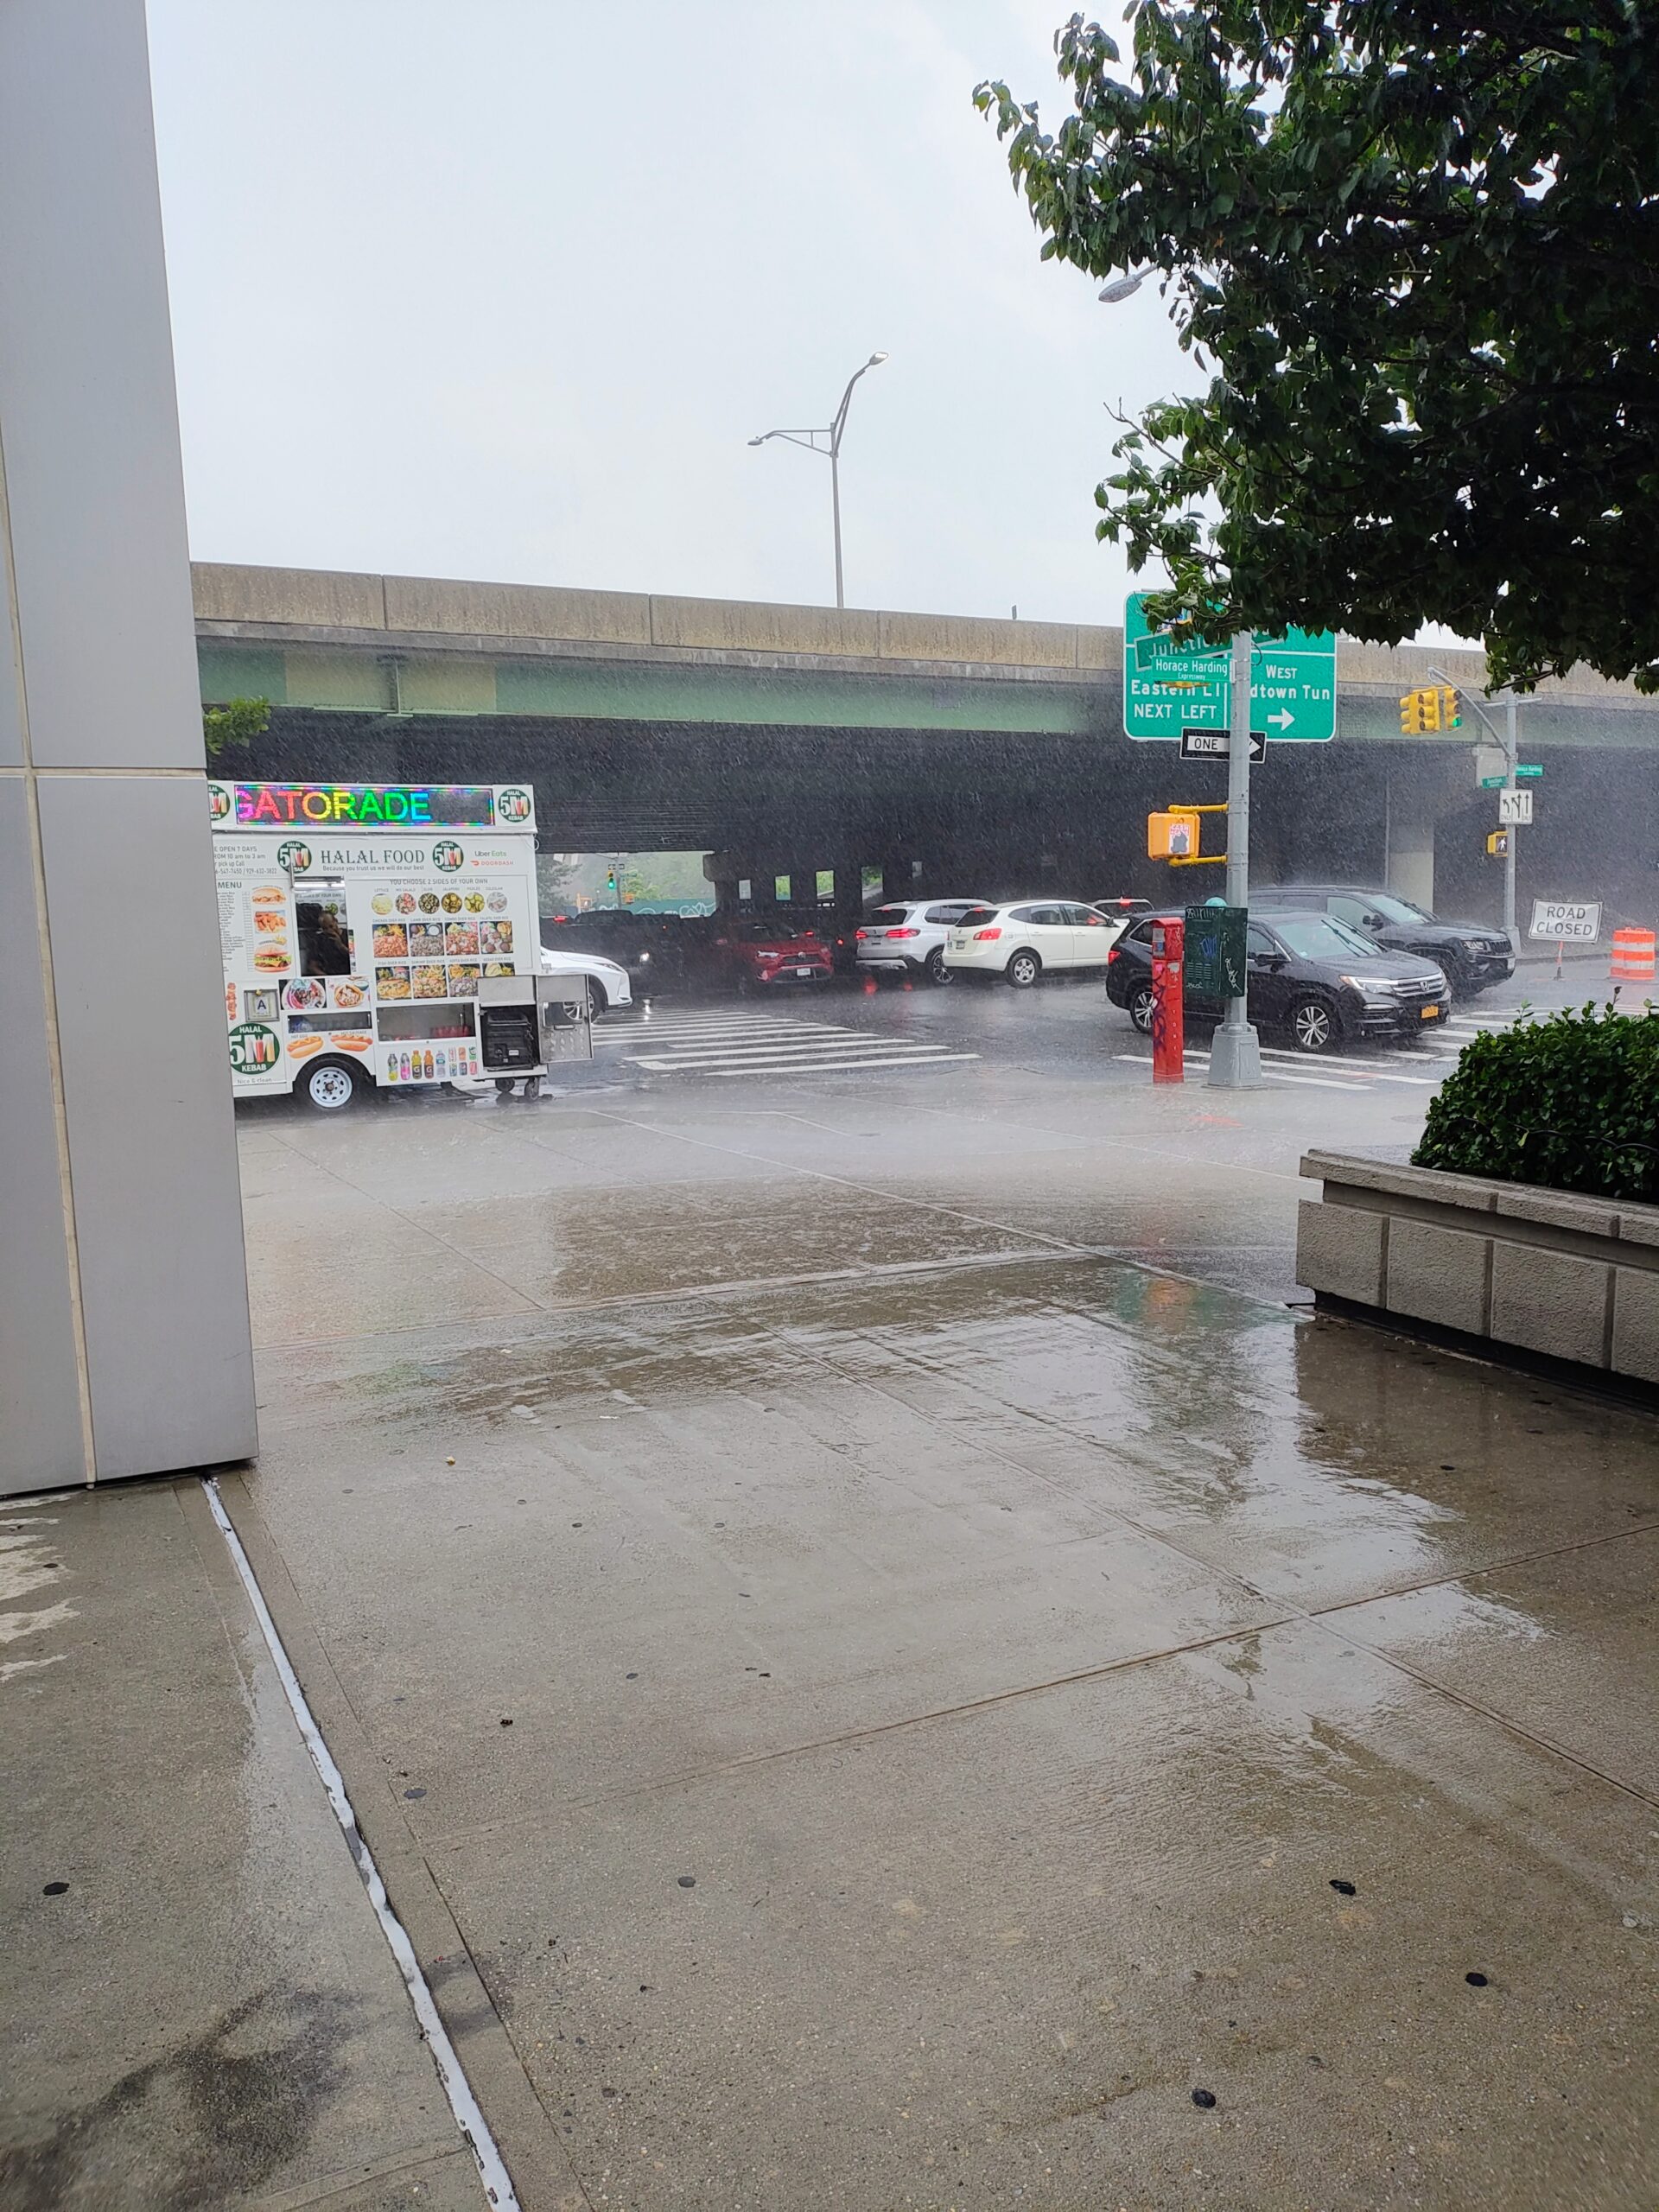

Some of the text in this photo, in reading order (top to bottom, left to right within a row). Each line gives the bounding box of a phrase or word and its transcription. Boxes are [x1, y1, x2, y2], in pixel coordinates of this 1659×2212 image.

[1156, 659, 1228, 677] Horace Harding
[1266, 664, 1297, 679] WEST
[1250, 684, 1331, 700] dtown Tun
[1134, 703, 1217, 720] NEXT LEFT
[1194, 738, 1218, 750] ONE
[237, 790, 431, 820] GATORADE
[499, 797, 529, 816] 5M
[279, 848, 309, 867] 5M
[321, 849, 425, 864] HALAL FOOD
[434, 847, 462, 866] 5M
[1547, 906, 1586, 919] ROAD
[1536, 921, 1592, 936] CLOSED
[257, 1000, 266, 1010] A
[229, 1033, 276, 1065] 5M
[242, 1064, 267, 1072] KEBAB
